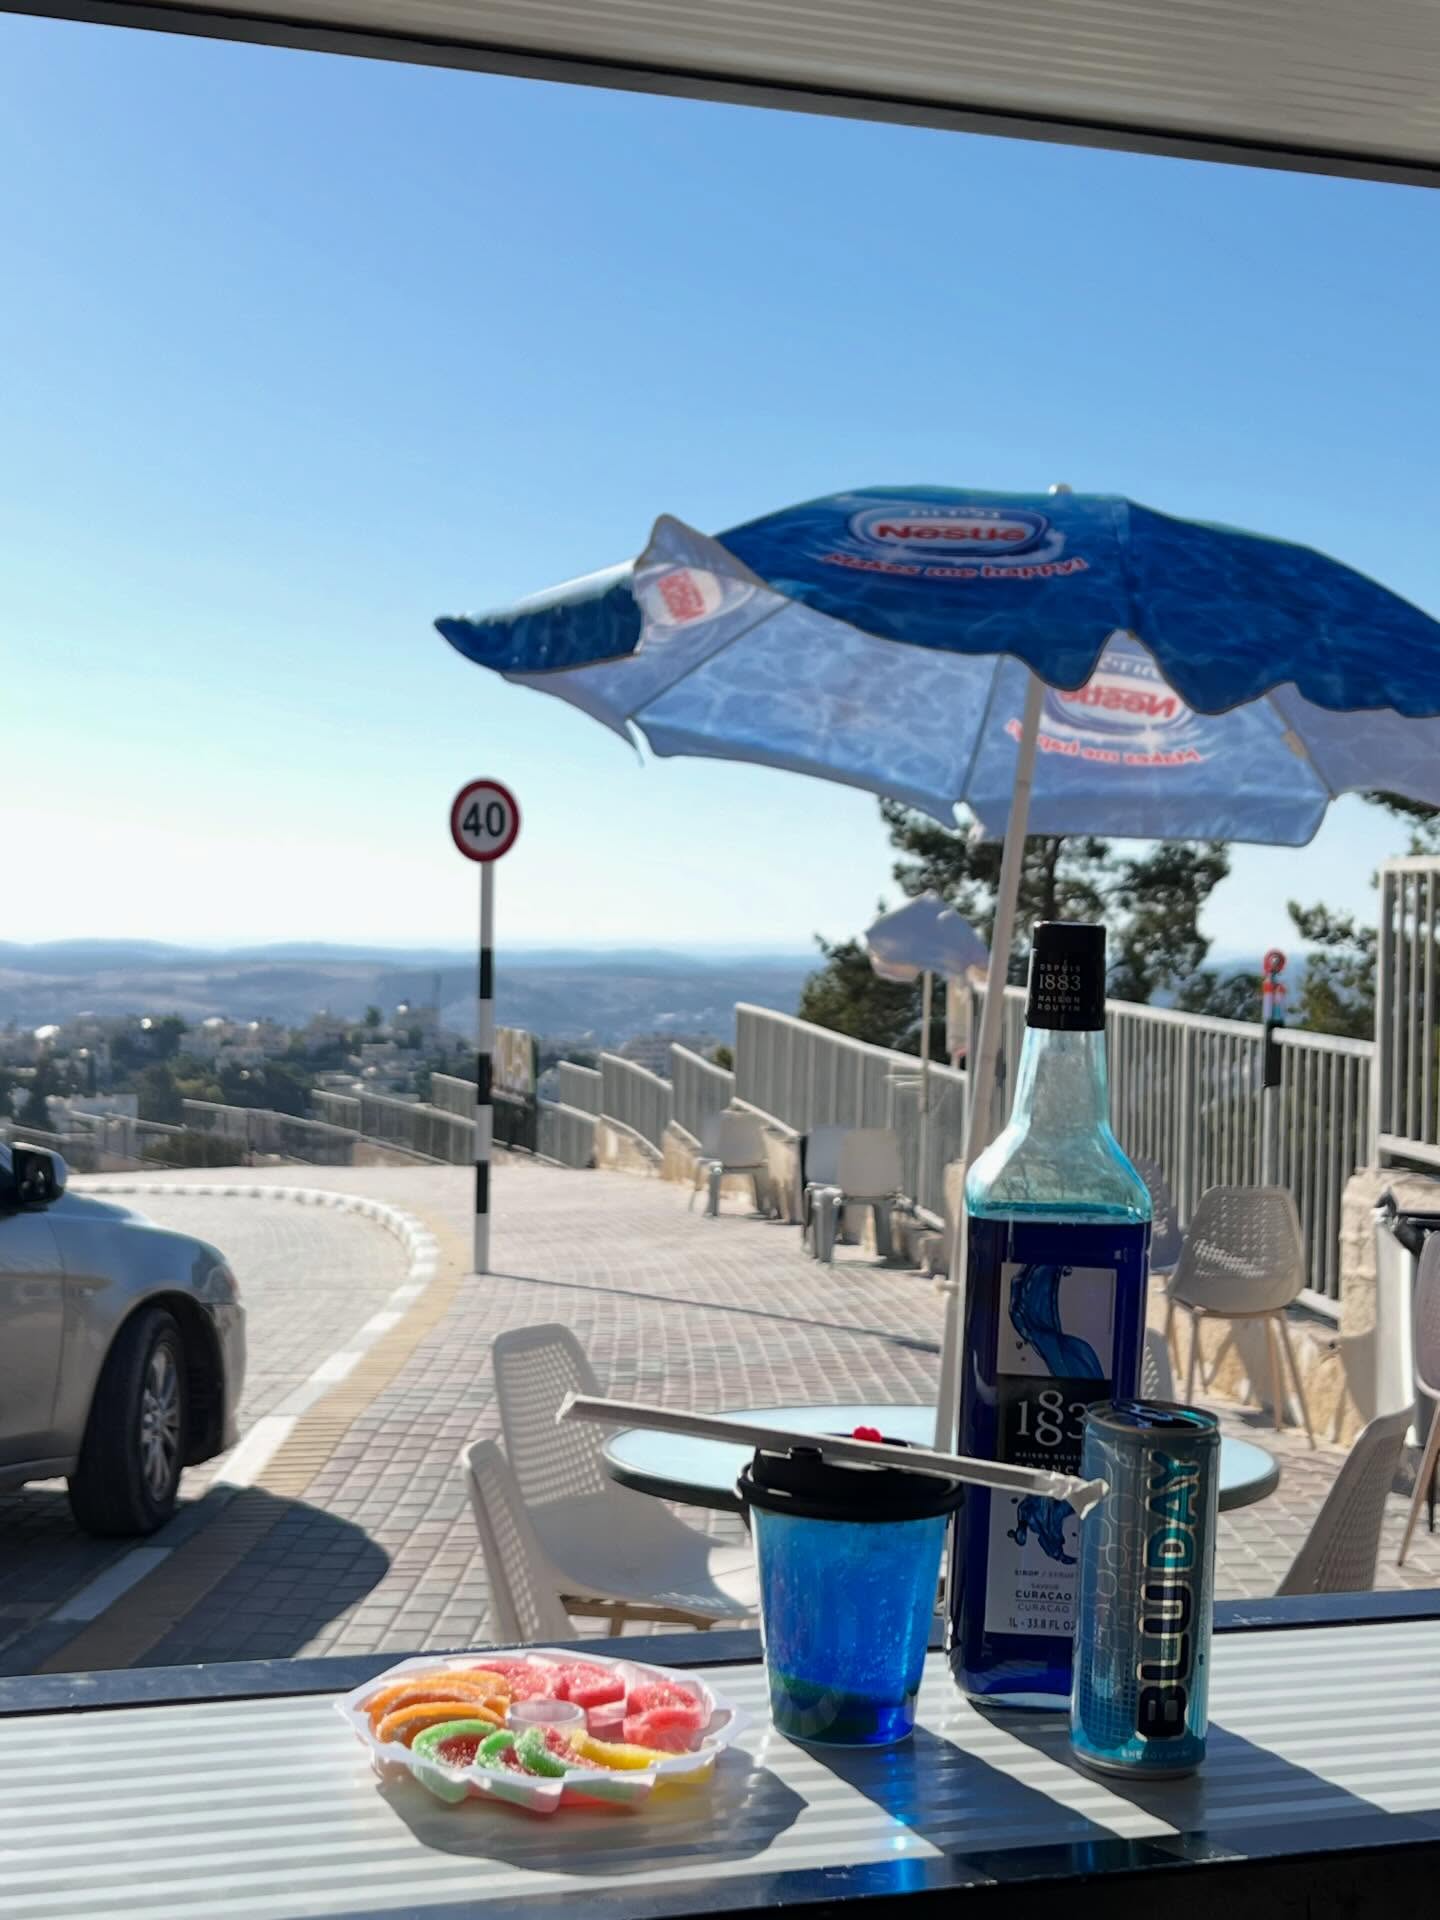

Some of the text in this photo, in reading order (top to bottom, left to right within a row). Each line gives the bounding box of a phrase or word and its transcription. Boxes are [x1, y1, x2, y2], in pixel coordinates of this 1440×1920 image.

[463, 801, 506, 837] 40
[1040, 974, 1081, 991] 1883
[1016, 1390, 1088, 1446] 1883
